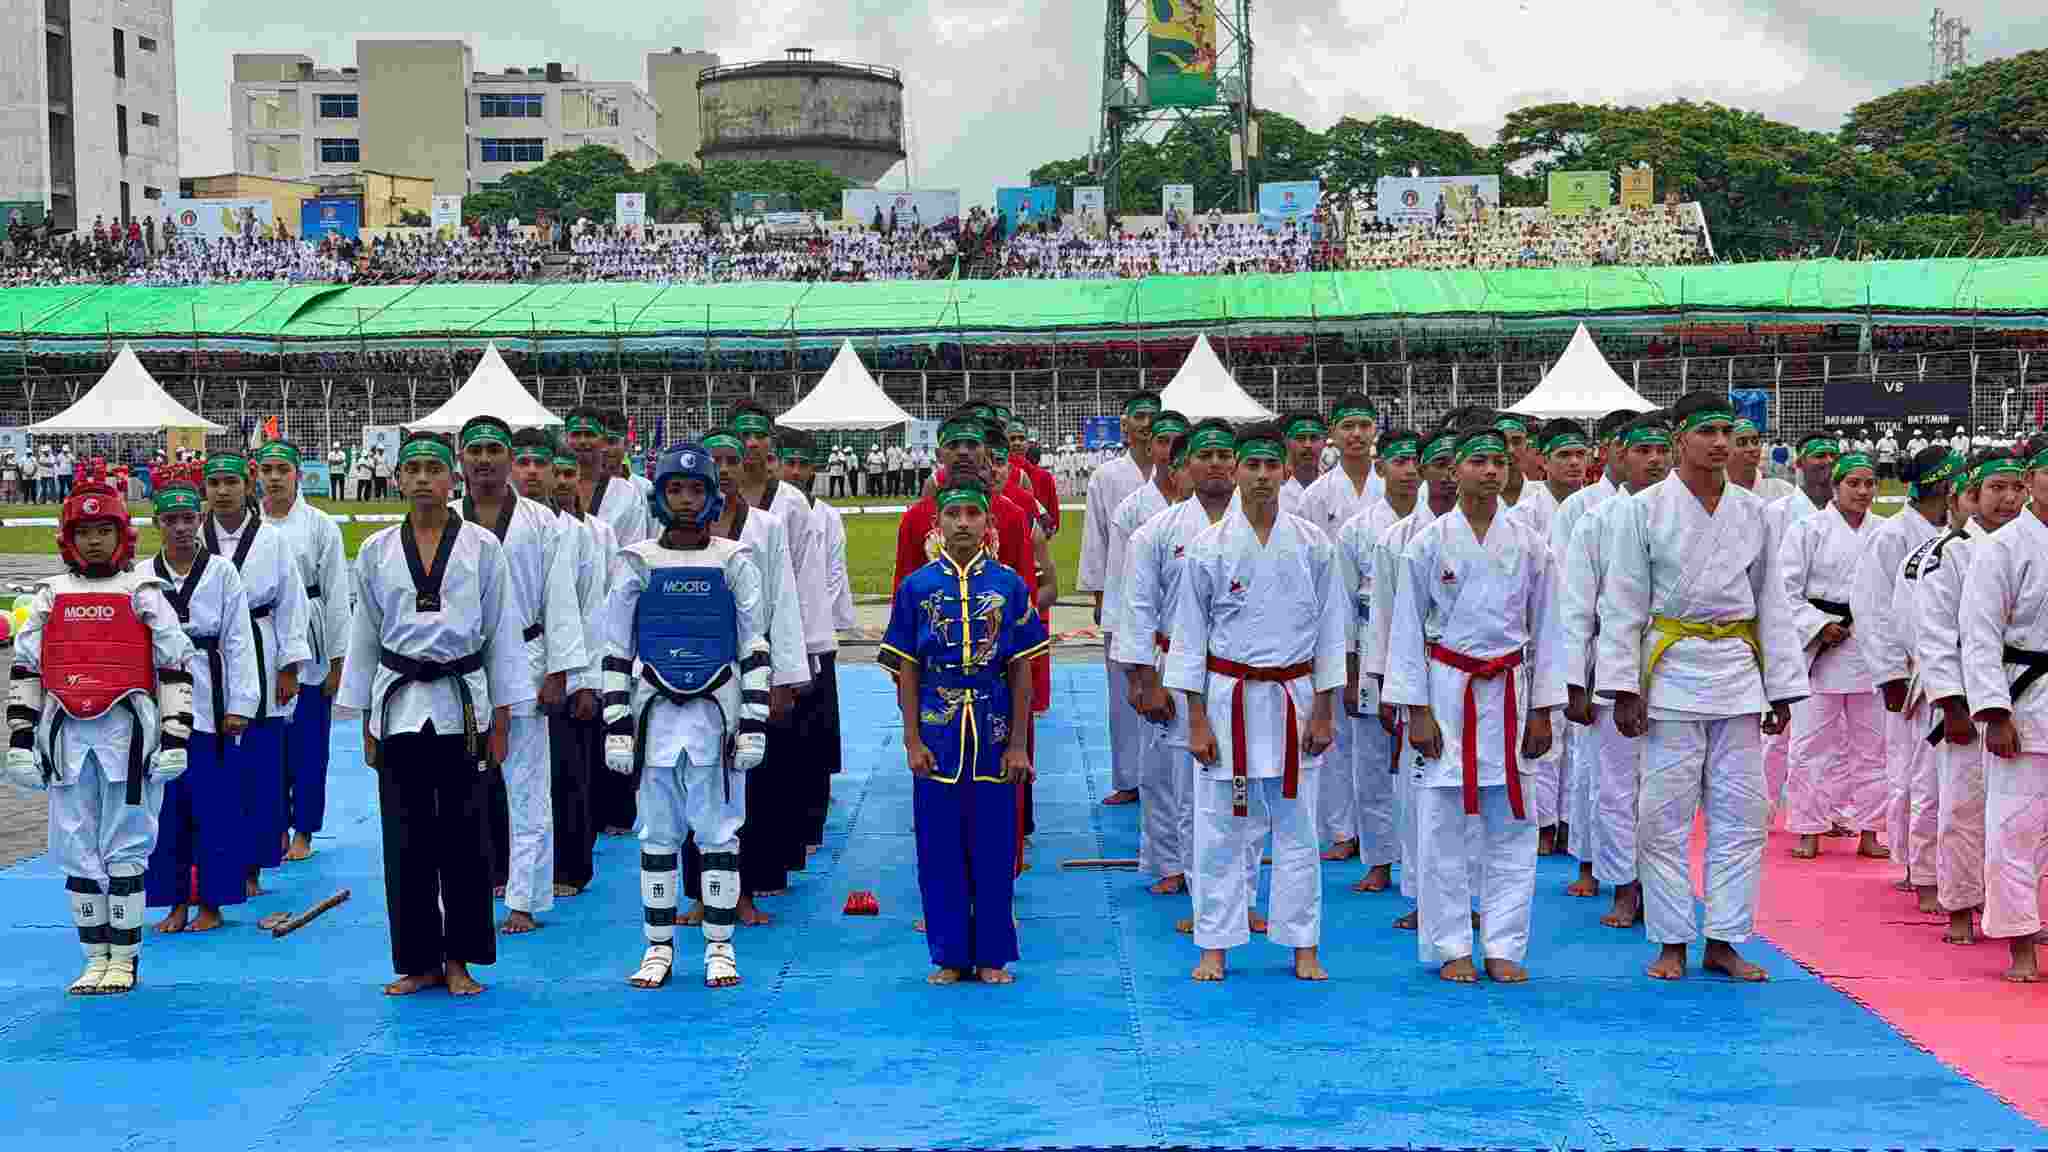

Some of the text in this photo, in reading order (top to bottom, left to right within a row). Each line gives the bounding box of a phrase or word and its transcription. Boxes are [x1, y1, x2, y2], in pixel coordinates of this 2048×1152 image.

[1883, 382, 1904, 393] VS
[1873, 421, 1904, 433] TOTAL
[663, 580, 712, 593] MOOTO
[64, 606, 115, 618] MOOTO
[684, 671, 694, 683] 2
